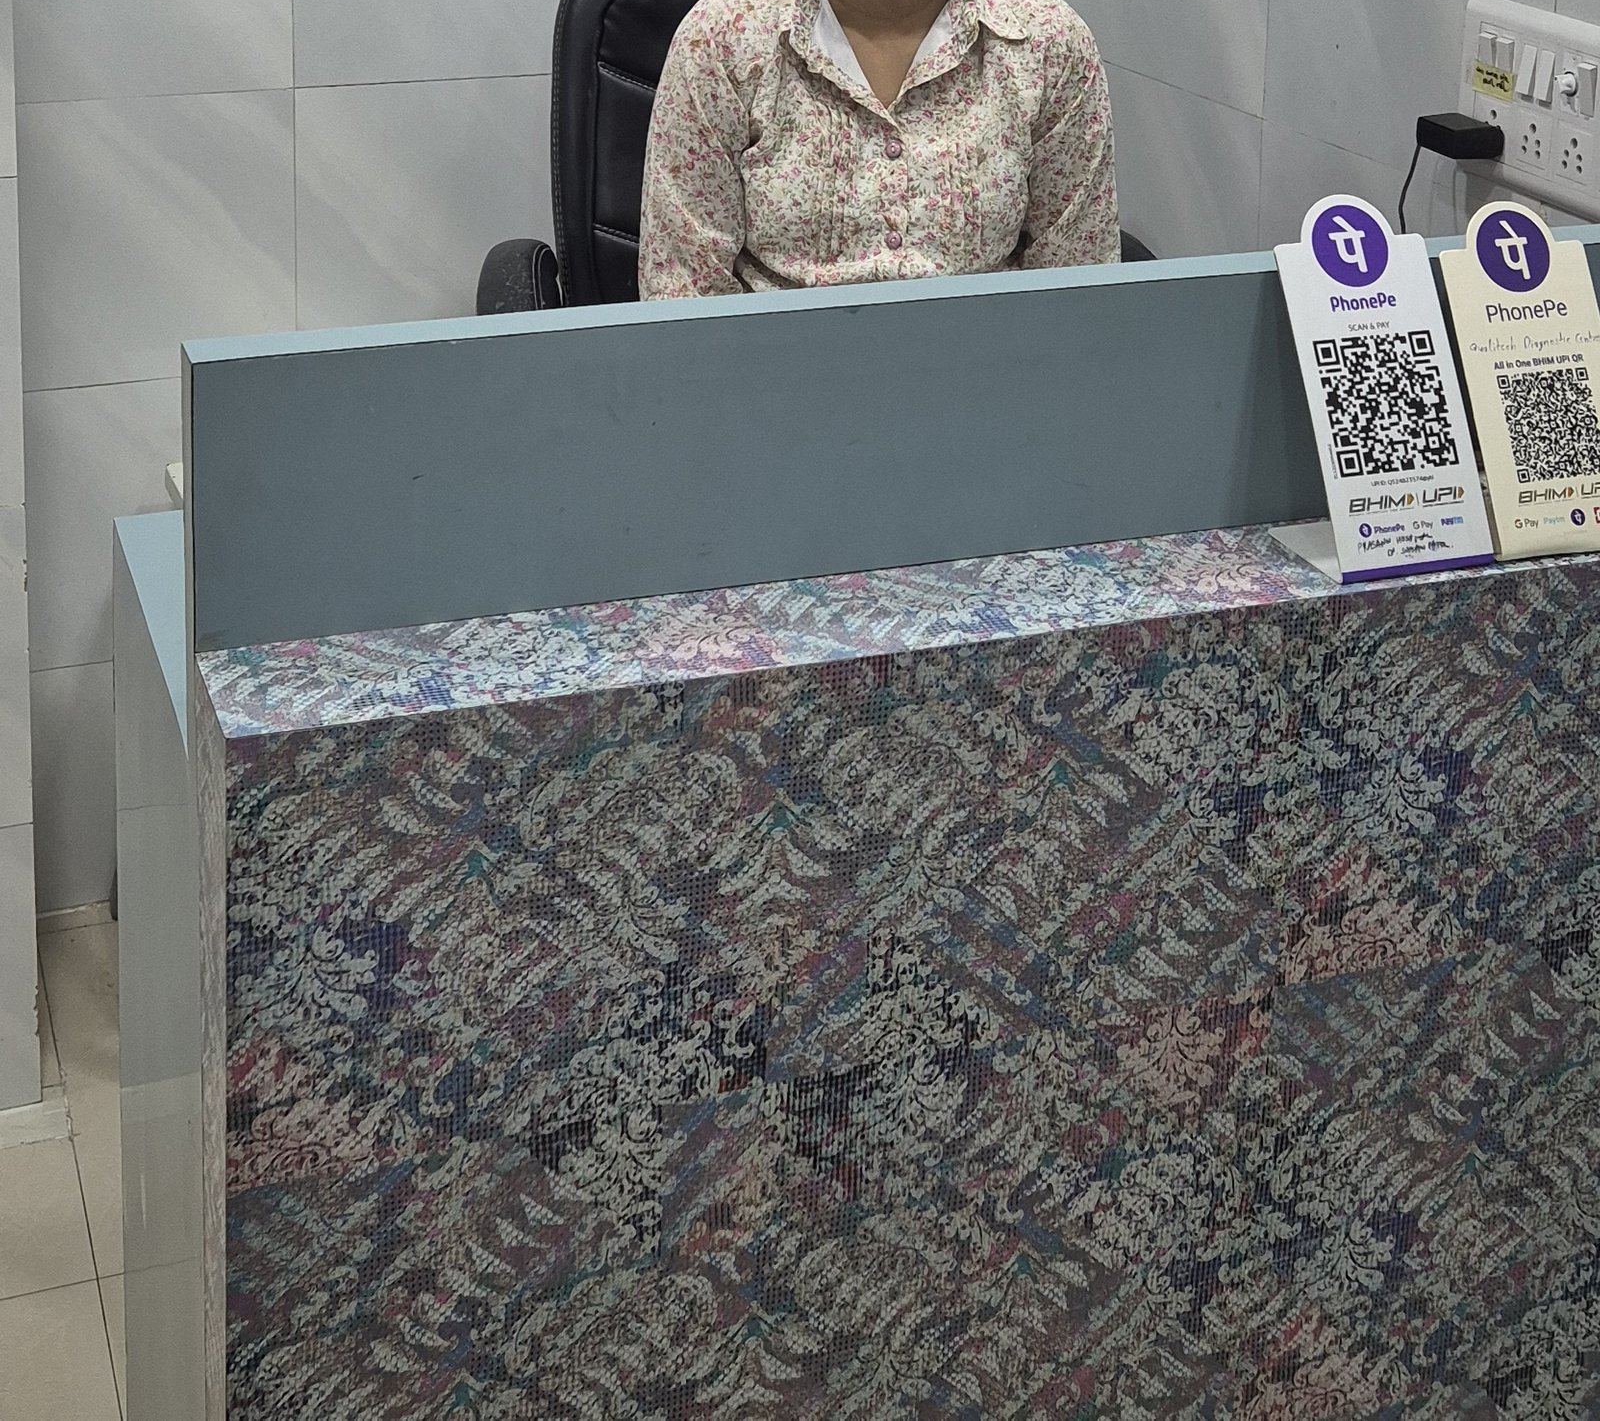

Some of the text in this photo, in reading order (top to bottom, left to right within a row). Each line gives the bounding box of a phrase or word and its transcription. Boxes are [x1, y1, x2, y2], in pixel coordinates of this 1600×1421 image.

[1330, 292, 1397, 312] PhonePe
[1485, 299, 1568, 323] PhonePe
[1348, 323, 1368, 332] SCAN
[1377, 321, 1390, 329] PAY
[1494, 354, 1584, 370] All in One BHIM UPI QR
[1349, 494, 1406, 513] BHIM
[1422, 486, 1457, 503] UPI
[1519, 487, 1567, 503] BHIM
[1374, 523, 1405, 534] PhonePe
